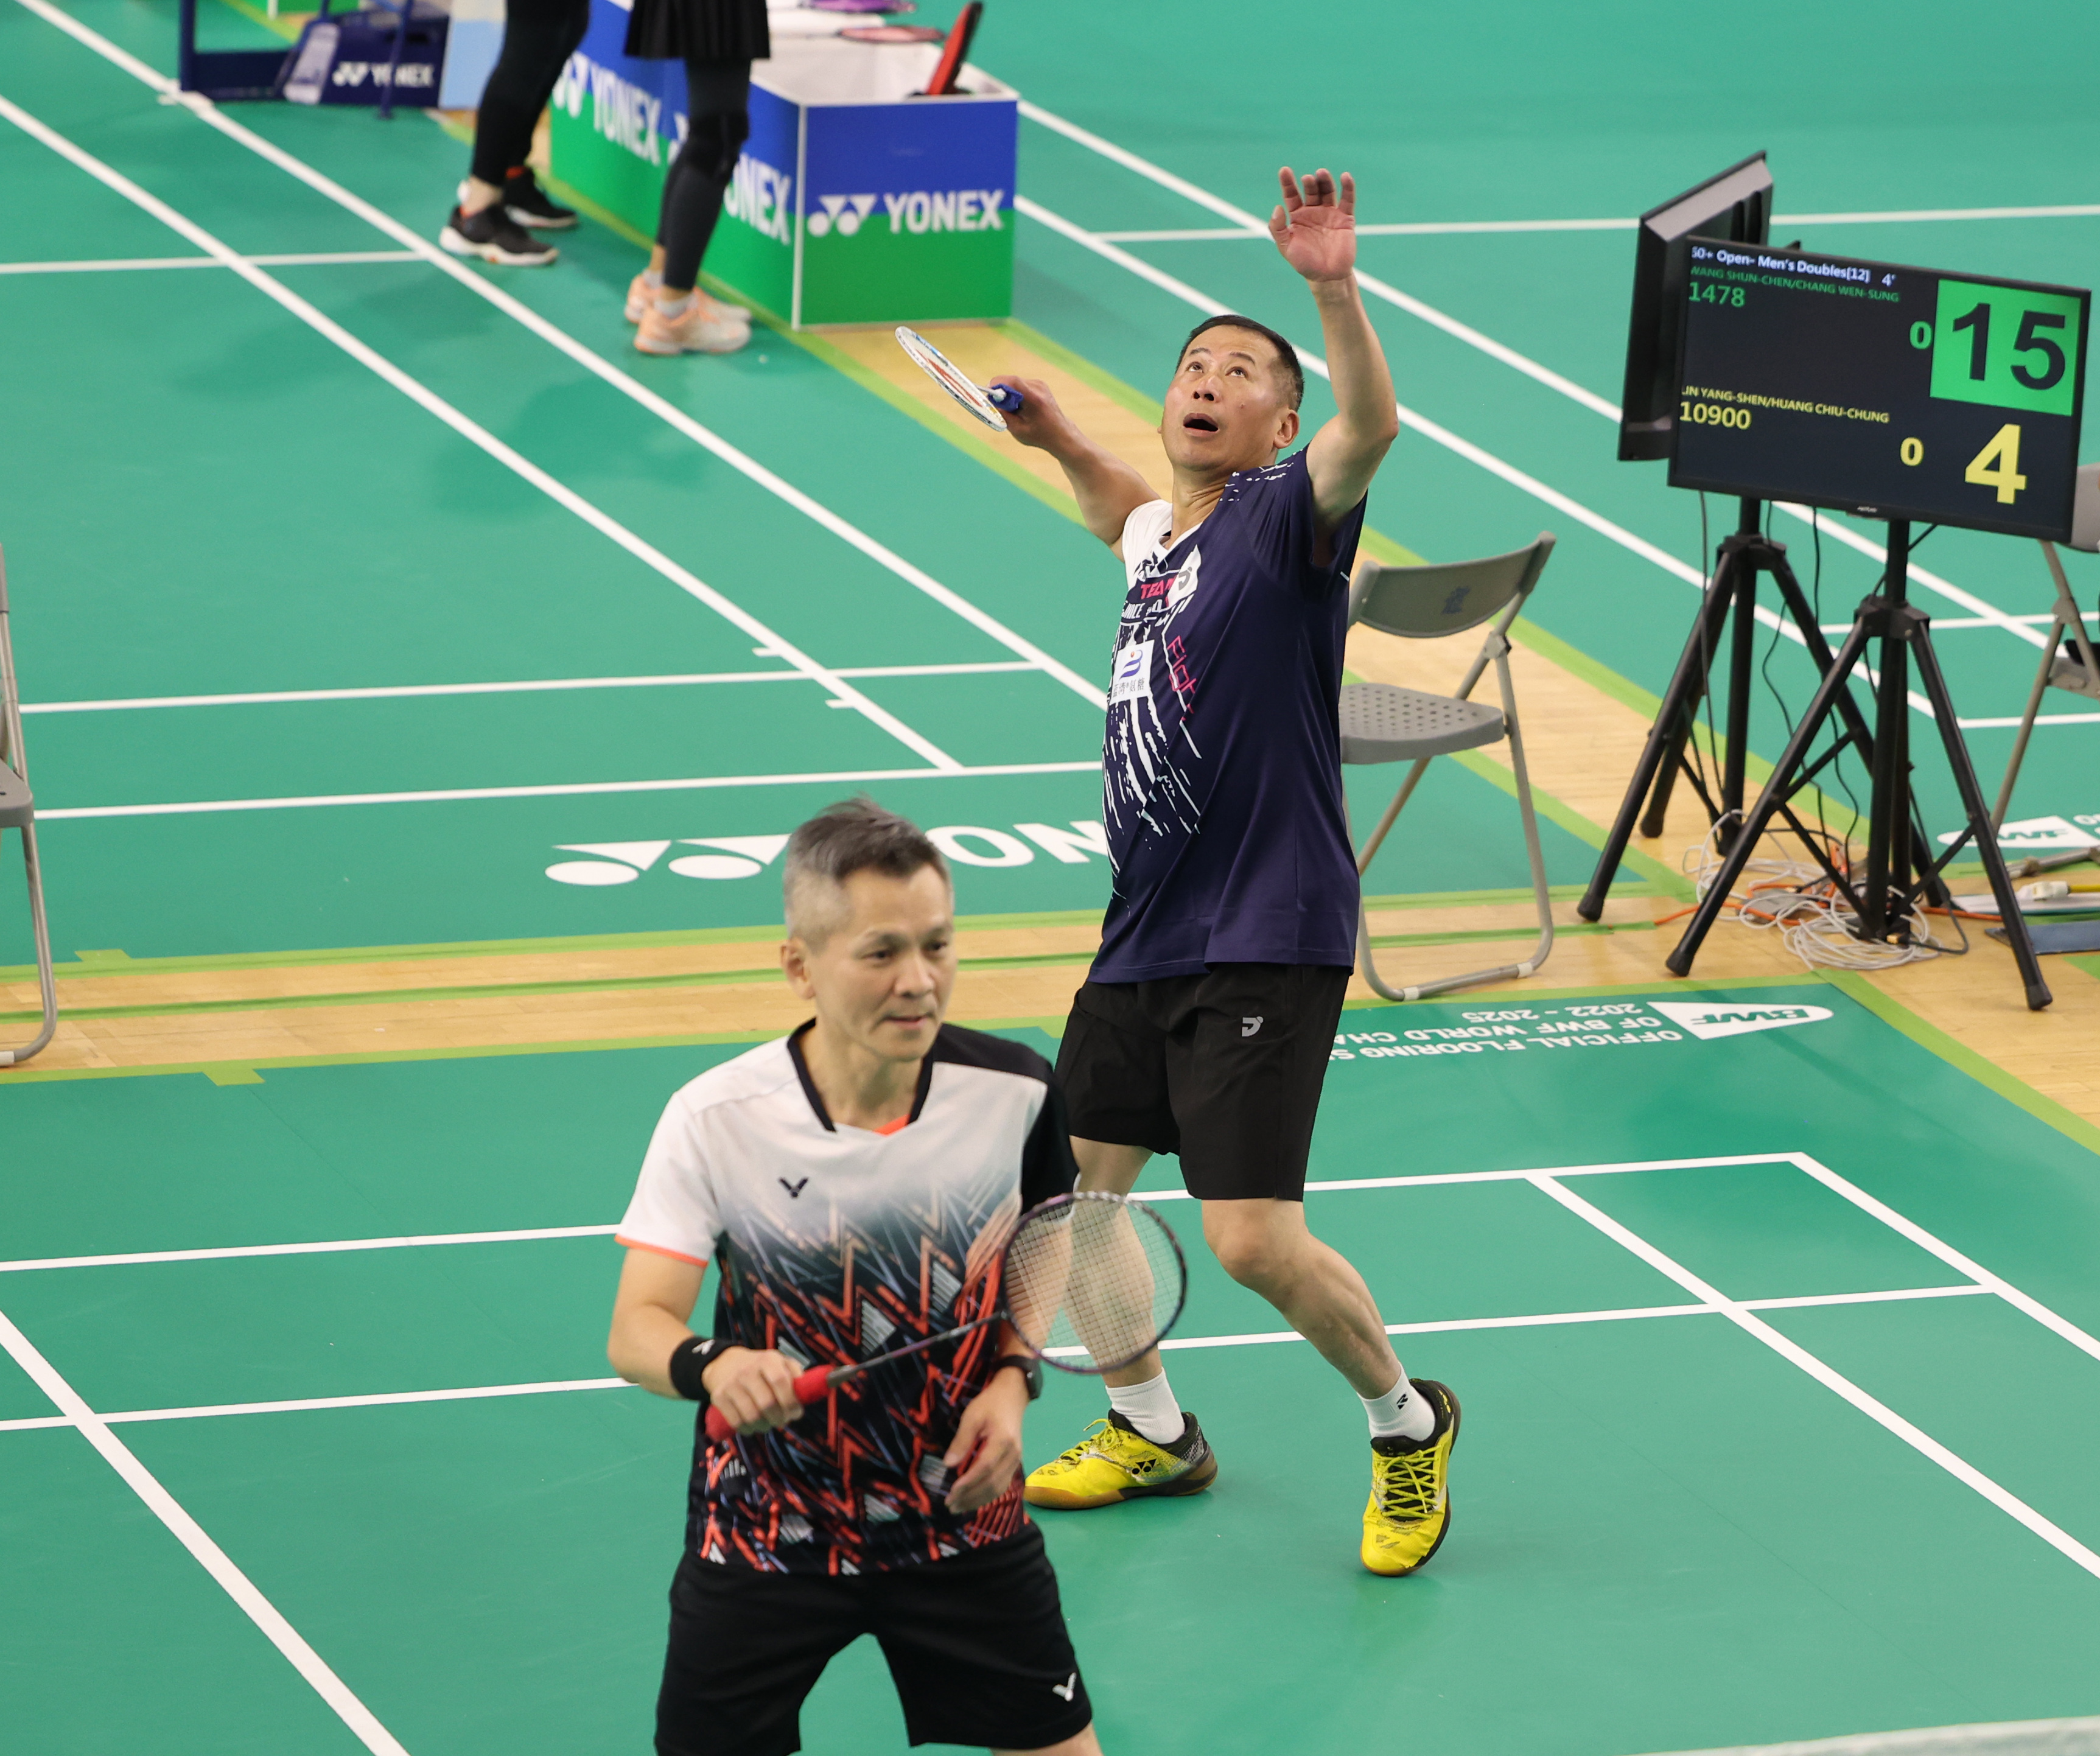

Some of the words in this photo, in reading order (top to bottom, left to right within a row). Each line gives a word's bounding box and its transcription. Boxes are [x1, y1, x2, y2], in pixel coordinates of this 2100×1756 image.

[590, 60, 661, 167] YONEX
[724, 152, 791, 245] ONEX
[884, 189, 1004, 234] YONEX
[1717, 249, 1755, 266] Open-
[1757, 254, 1795, 272] Men's
[1797, 261, 1871, 284] Doubles[12]
[1689, 281, 1746, 307] 1478
[1726, 270, 1836, 295] SHUN-CHEN/CHANG
[1838, 285, 1900, 303] WEN-SUNG
[1909, 321, 1933, 349] 0
[1953, 302, 2065, 390] 15
[1679, 401, 1752, 430] 10900
[1701, 387, 1813, 414] YANG-SHEN/HUANG
[1815, 403, 1890, 424] CHIU-CHUNG
[1900, 437, 1925, 466] 0
[1964, 423, 2028, 505] 4
[1461, 1009, 1540, 1023] 2025
[1564, 1003, 1643, 1017] 2022
[1619, 1016, 1662, 1029] OF
[1690, 1008, 1810, 1026] BWF
[1403, 1024, 1528, 1041] WORLD
[1526, 1030, 1683, 1048] OFFICIAL
[1536, 1019, 1612, 1034] BWF
[1359, 1039, 1527, 1058] FLOORING
